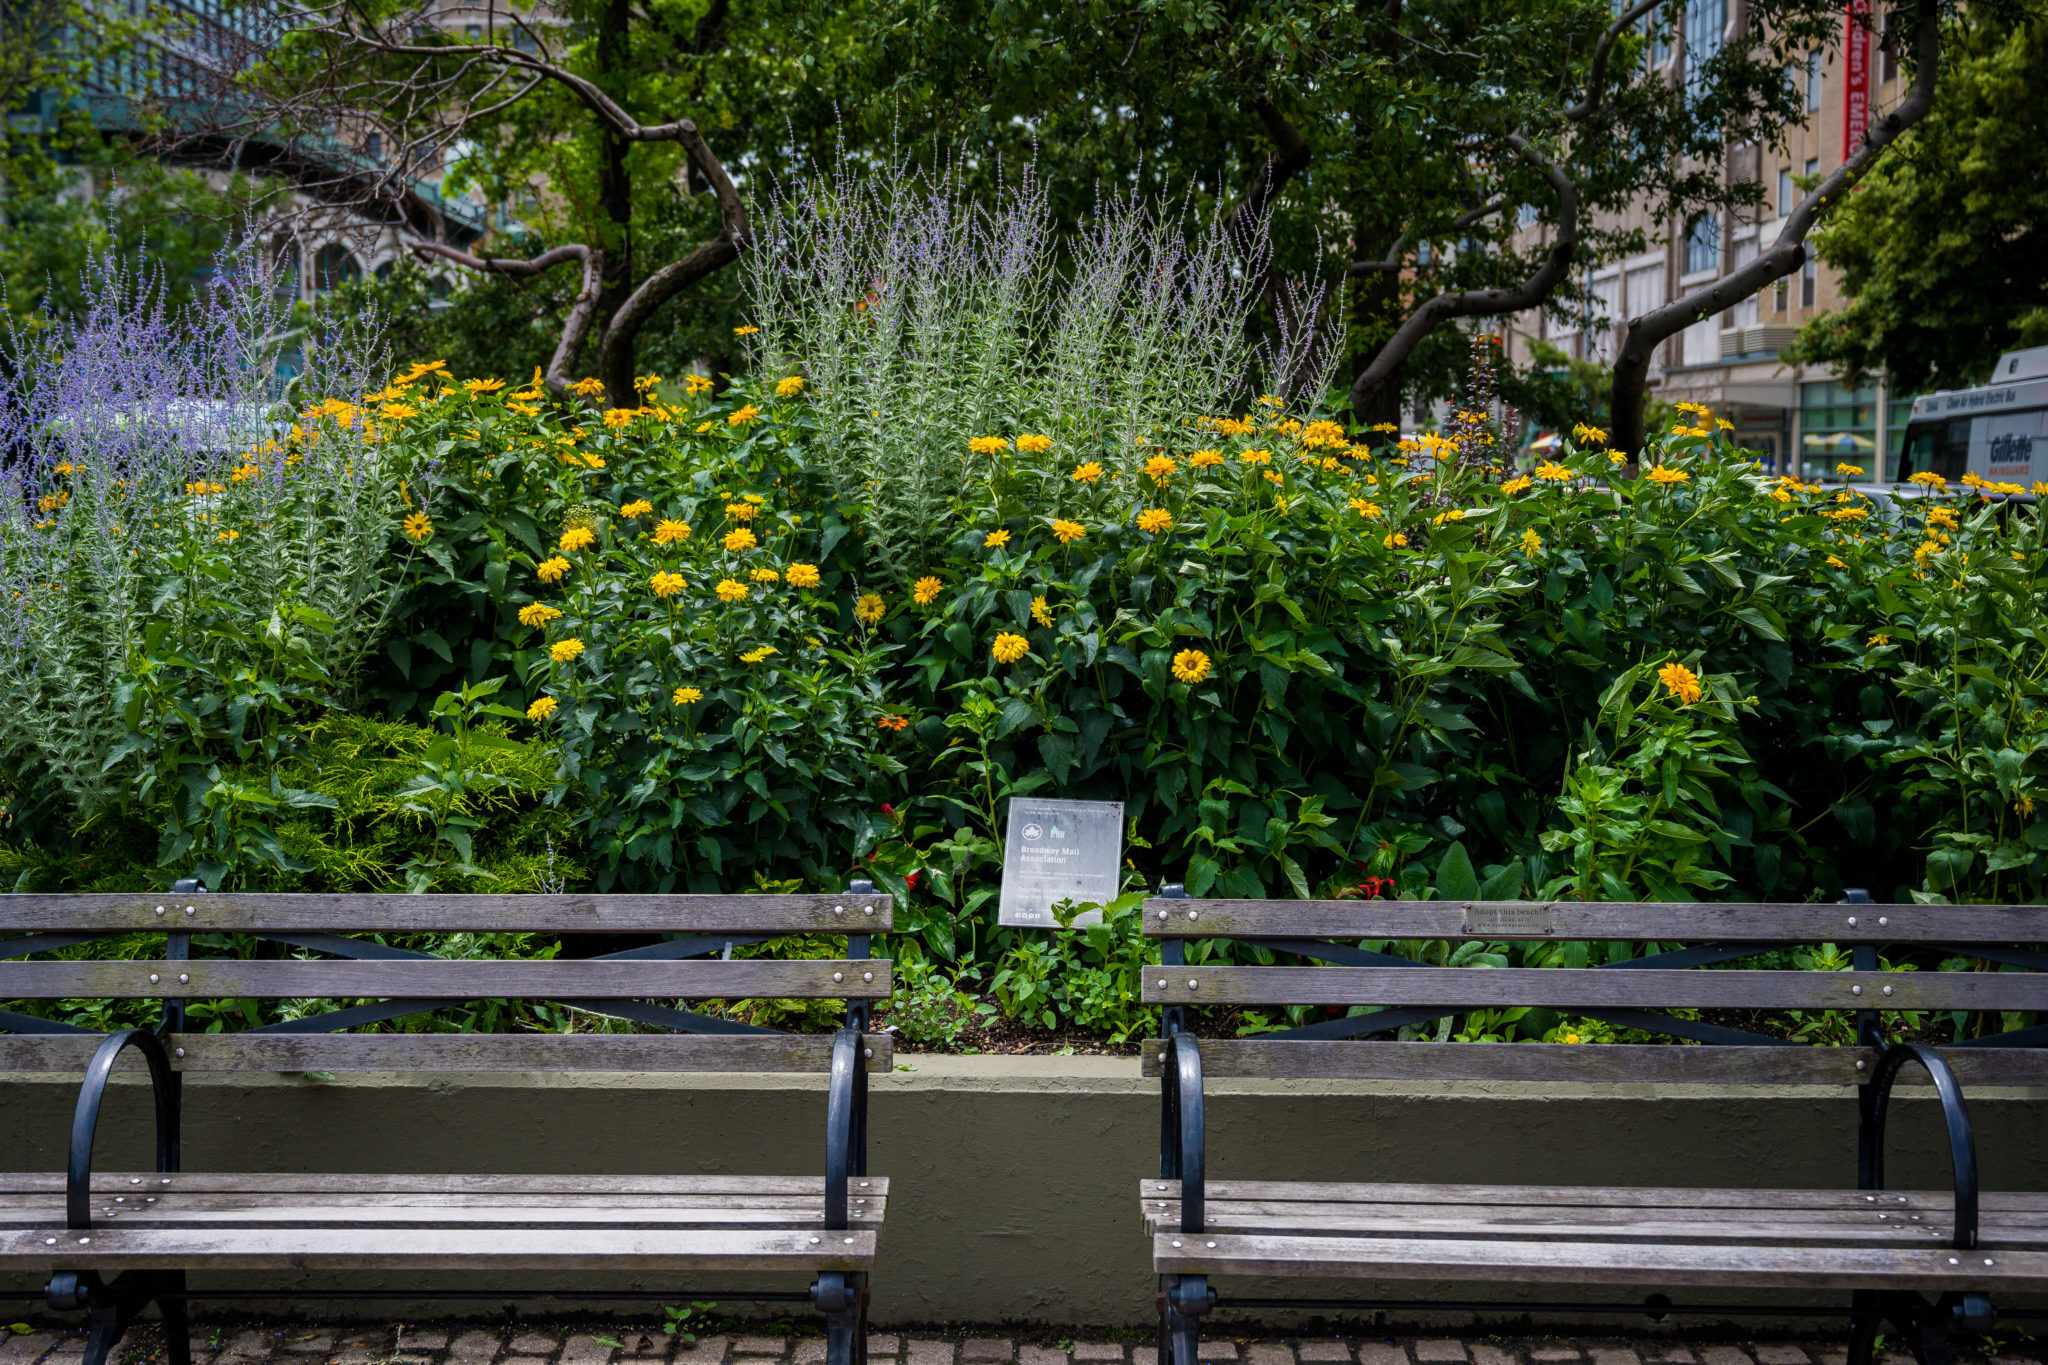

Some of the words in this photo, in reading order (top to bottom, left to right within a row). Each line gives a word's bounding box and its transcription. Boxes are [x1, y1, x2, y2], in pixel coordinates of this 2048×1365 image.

[1969, 393, 1985, 408] Hybrid
[1986, 391, 2005, 405] Electric
[2006, 389, 2017, 402] Bus
[1990, 432, 2033, 463] Gillette
[1021, 846, 1060, 856] Broadway
[1062, 847, 1080, 856] Mall
[1020, 855, 1066, 864] Association
[1474, 908, 1497, 916] Adopt
